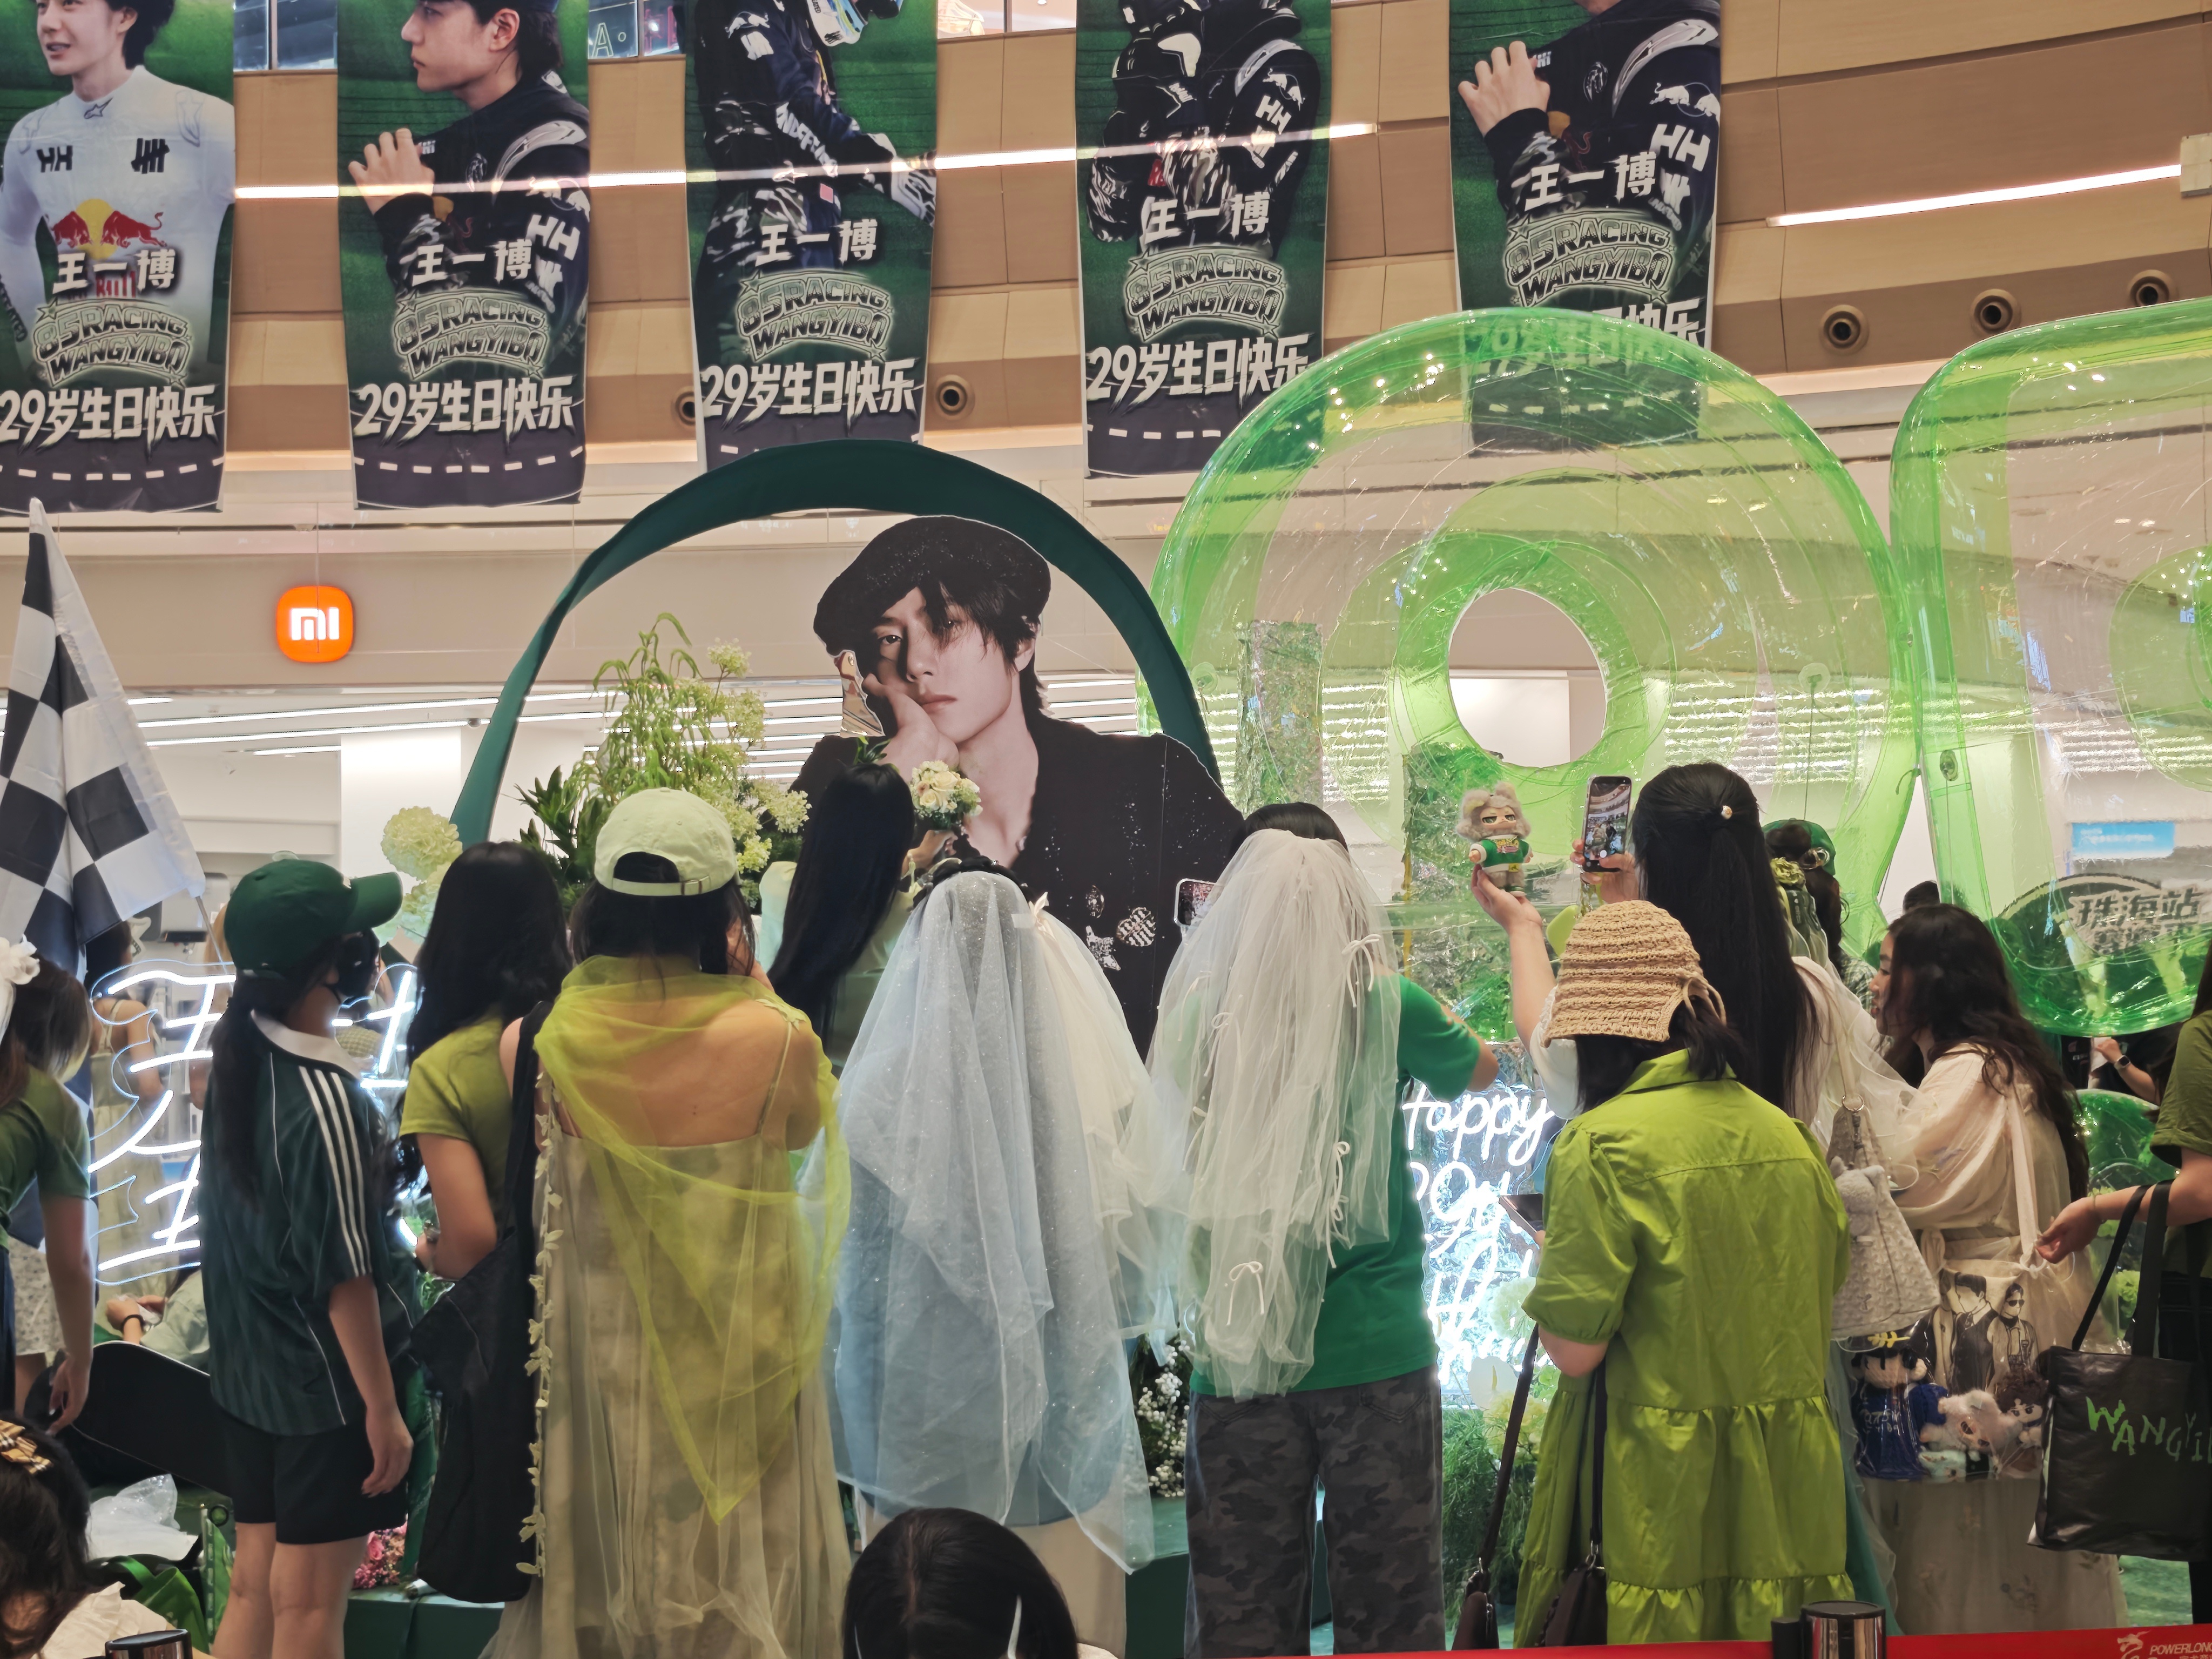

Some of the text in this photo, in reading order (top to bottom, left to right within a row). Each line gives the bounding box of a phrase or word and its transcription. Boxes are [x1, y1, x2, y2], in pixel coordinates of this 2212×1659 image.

[37, 145, 73, 173] HH
[1649, 124, 1710, 171] HH
[1525, 151, 1657, 211] 王一博
[525, 214, 580, 260] HH
[756, 219, 878, 266] 王一博
[1145, 191, 1270, 244] 王一博
[52, 249, 176, 295] 王一博
[412, 239, 532, 287] 王一博
[1519, 247, 1673, 307] WANGYIBO
[749, 307, 890, 361] WANGYIBO
[1138, 282, 1285, 341] WANGYIBO
[48, 331, 190, 386] WANGYIBO
[407, 324, 548, 380] WANGYIBO
[1085, 333, 1310, 416] 29岁生日快乐
[0, 385, 218, 463] 29岁生日快乐
[350, 375, 576, 454] 29岁生日快乐
[700, 359, 919, 436] 29岁生日快乐
